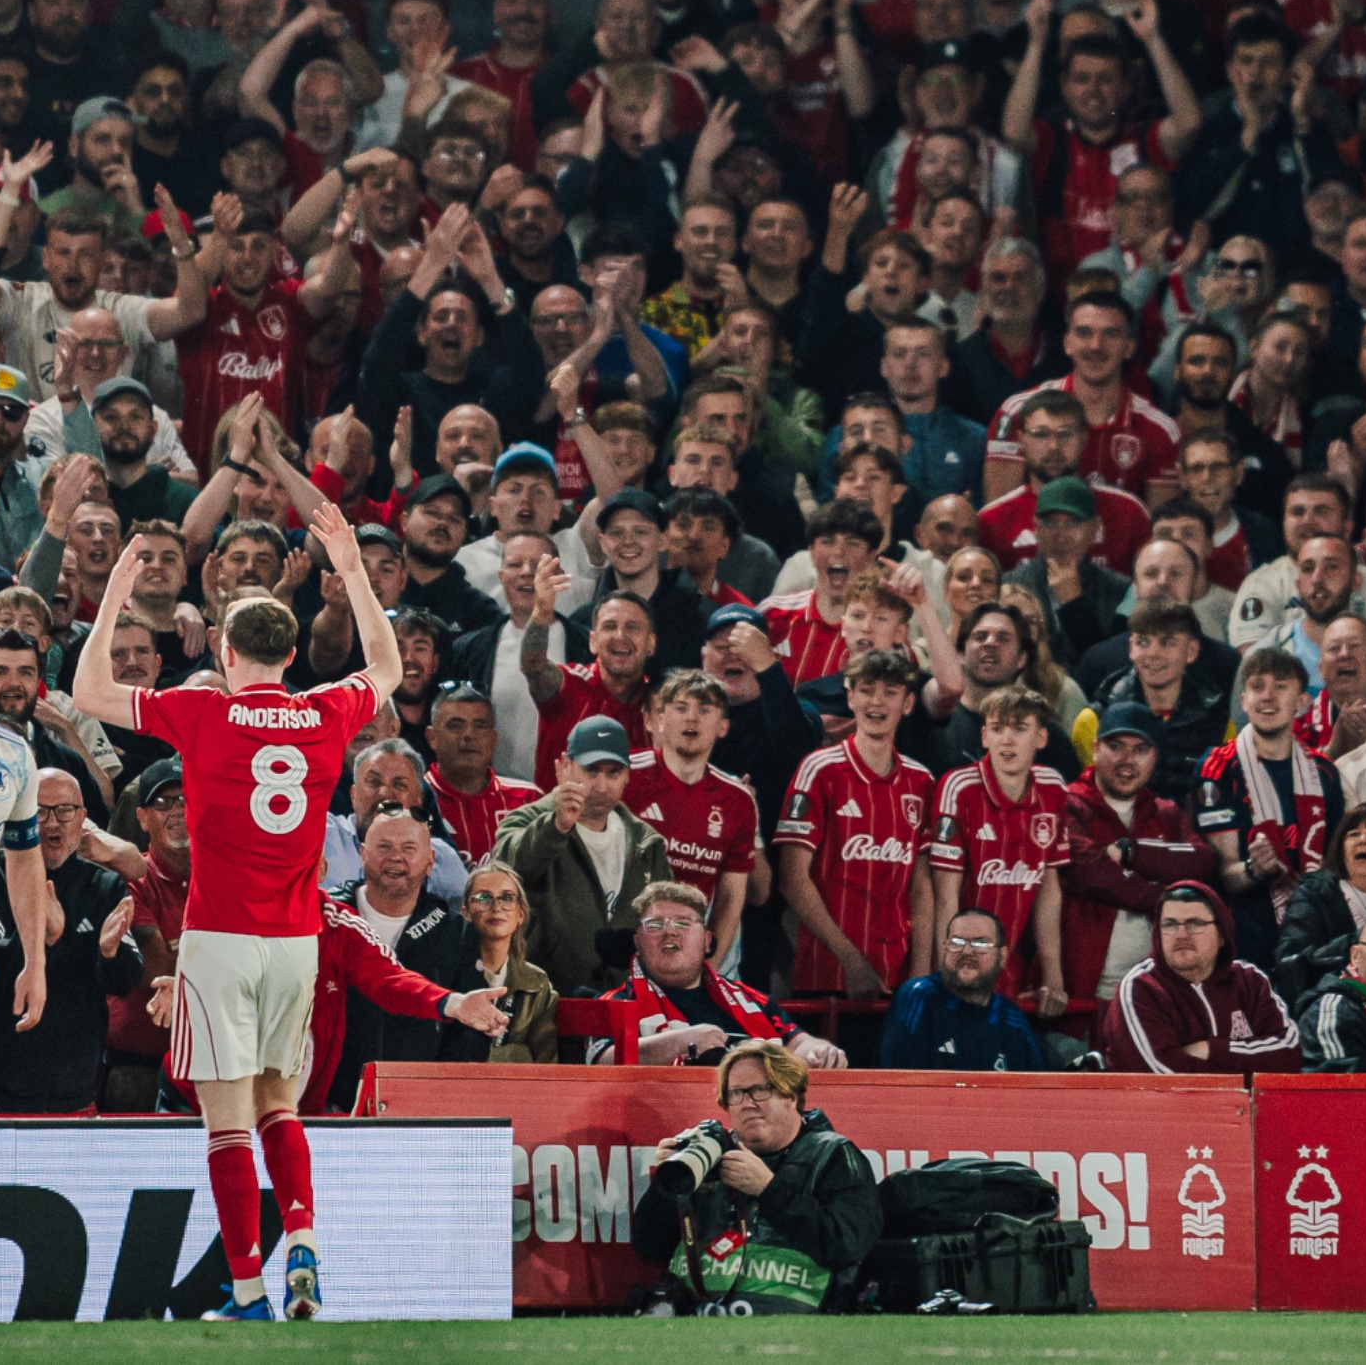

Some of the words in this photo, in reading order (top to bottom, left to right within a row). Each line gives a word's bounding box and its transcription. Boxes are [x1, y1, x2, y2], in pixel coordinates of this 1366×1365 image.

[227, 703, 322, 730] ANDERSON
[249, 744, 309, 835] 8
[405, 906, 447, 940] MONCLER
